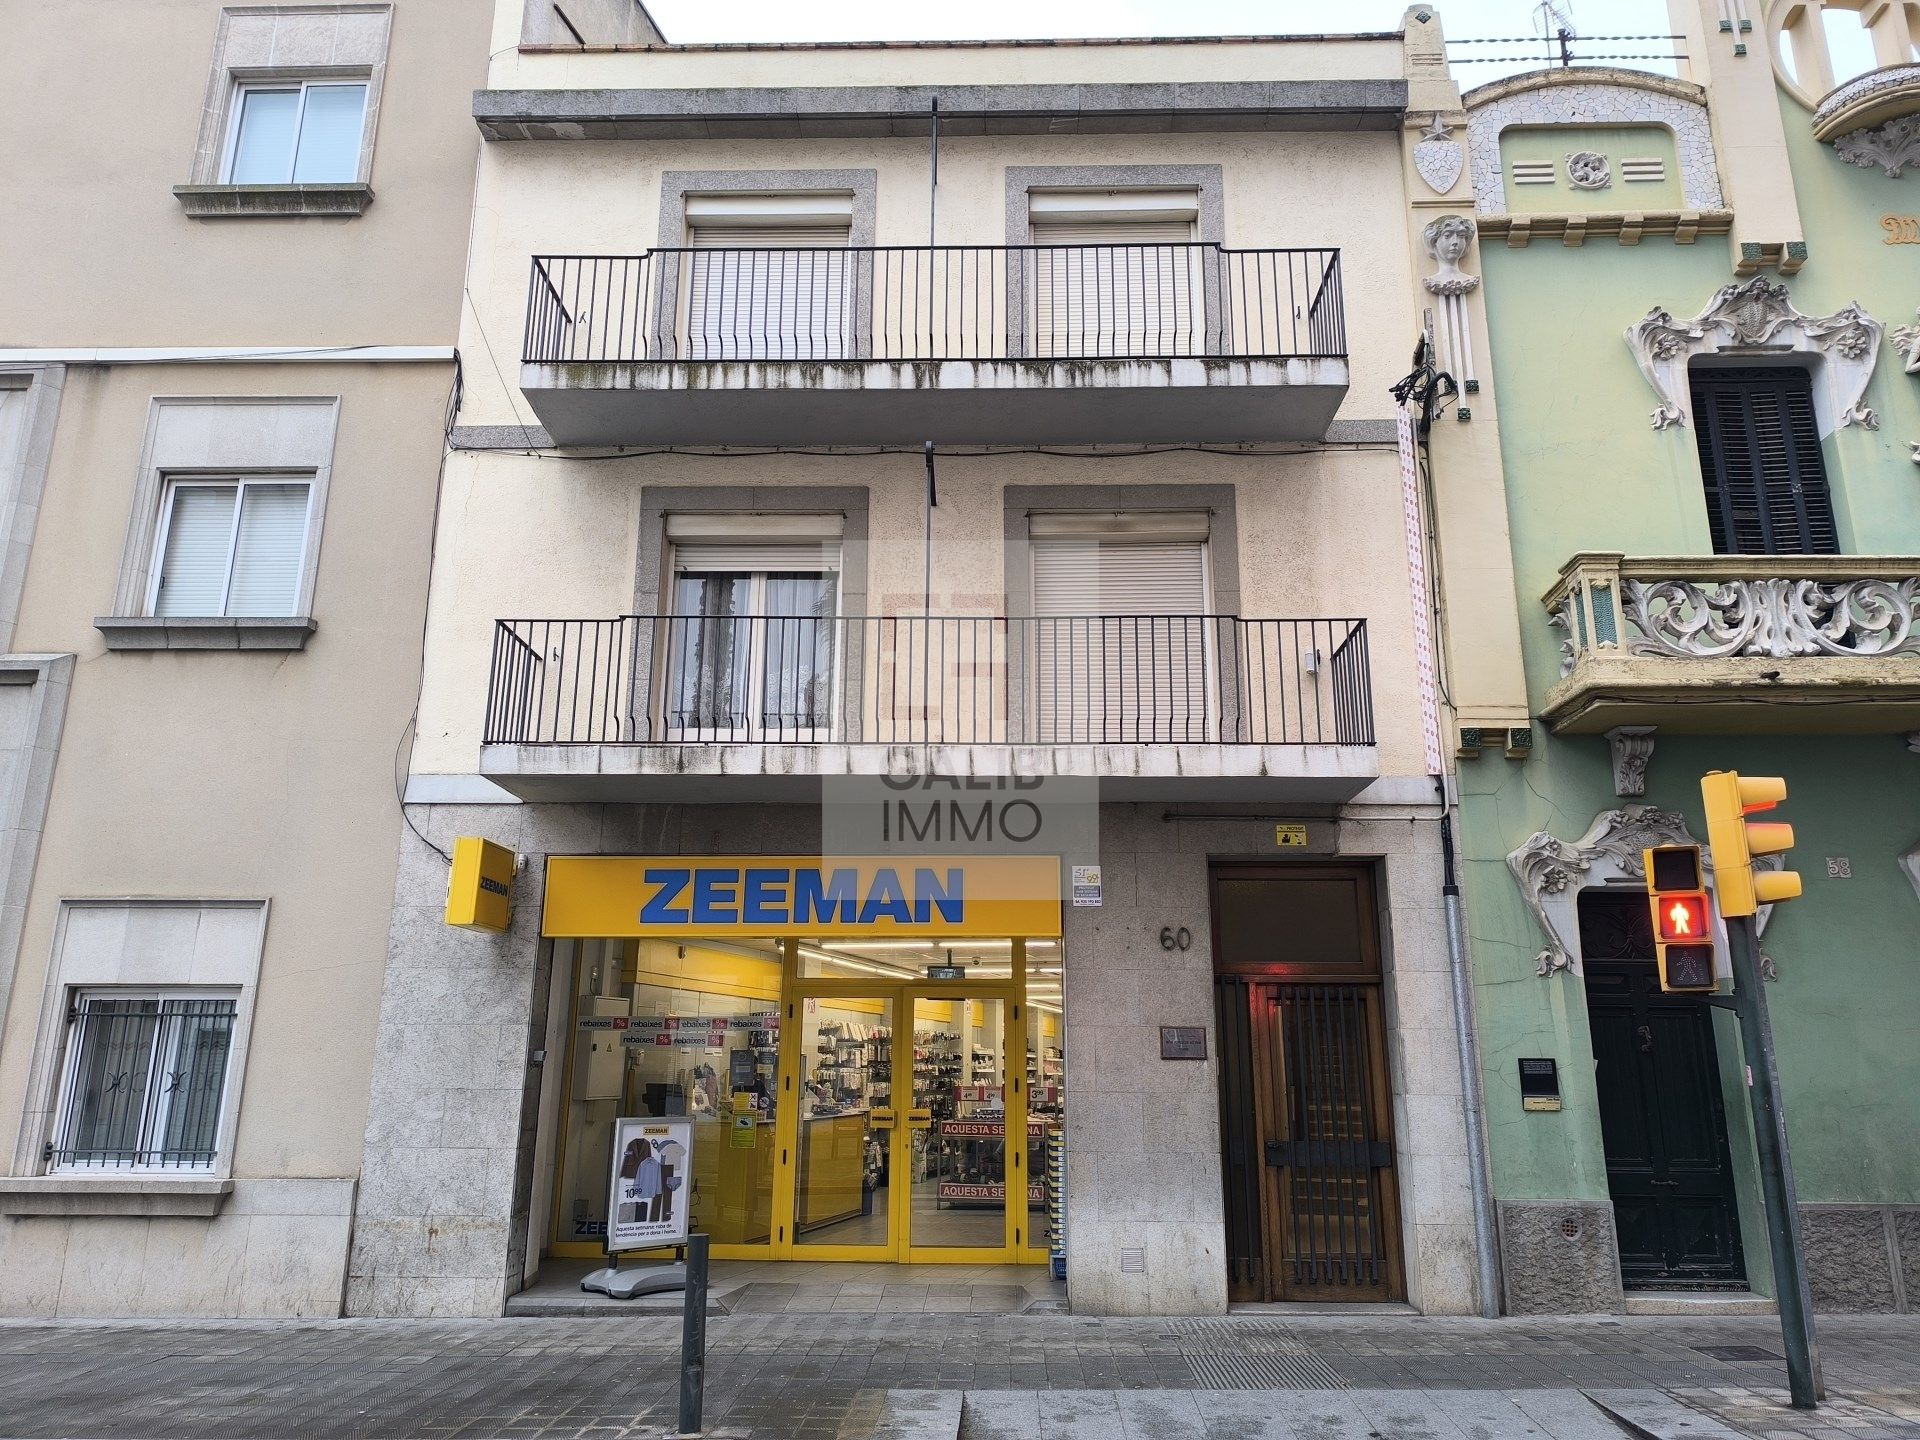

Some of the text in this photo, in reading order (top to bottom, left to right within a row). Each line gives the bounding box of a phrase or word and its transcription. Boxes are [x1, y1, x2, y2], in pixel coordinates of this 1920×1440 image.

[1829, 860, 1850, 875] 58
[480, 876, 508, 897] ZEEMAN
[639, 868, 965, 924] ZEEMAN
[1160, 927, 1191, 950] 60
[579, 1019, 612, 1028] rebaixes
[630, 1019, 663, 1028] rebaixes
[730, 1019, 762, 1028] rebaixes
[623, 1036, 655, 1045] rebaixes
[1031, 1089, 1044, 1099] 399
[944, 1124, 990, 1135] AQUESTA
[943, 1186, 988, 1197] AQUESTA
